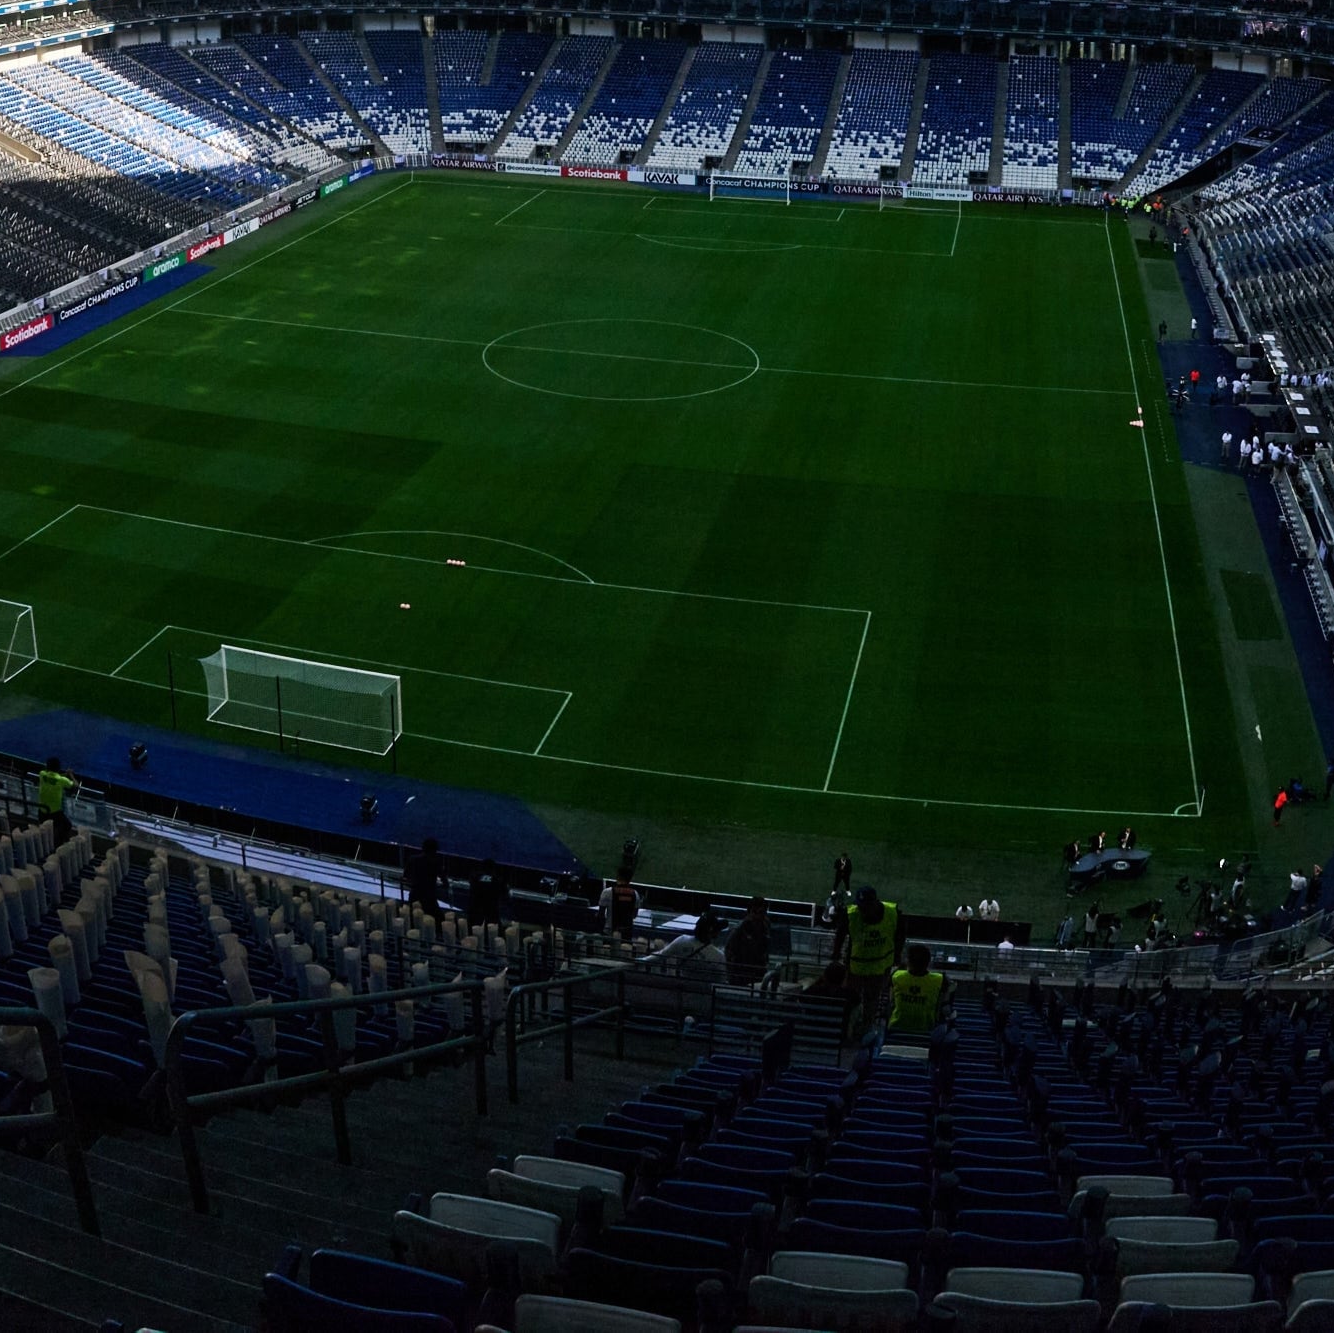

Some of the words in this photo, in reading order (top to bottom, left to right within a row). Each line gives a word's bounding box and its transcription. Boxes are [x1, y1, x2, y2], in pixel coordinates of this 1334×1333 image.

[432, 159, 459, 167] QATAR
[461, 161, 496, 170] AIRWAYS
[567, 167, 621, 180] Scotiabank
[644, 172, 678, 184] KAVAK
[325, 179, 343, 194] aramco
[706, 177, 742, 186] Concacaf
[744, 179, 798, 190] CHAMPIONS
[800, 182, 819, 191] CUP
[833, 185, 863, 194] QATAR
[865, 186, 903, 196] AIRWAYS
[295, 190, 317, 205] JETOUR
[909, 190, 931, 198] Hilton
[973, 193, 1004, 202] QATAR
[259, 210, 274, 227] QATAR
[232, 222, 251, 240] KAVAK
[190, 235, 221, 260] Scotiabank
[153, 255, 179, 277] aramco
[60, 300, 87, 321] Concacaf
[87, 282, 124, 308] CHAMPIONS
[124, 276, 139, 290] CUP
[4, 318, 48, 349] Scotiabank
